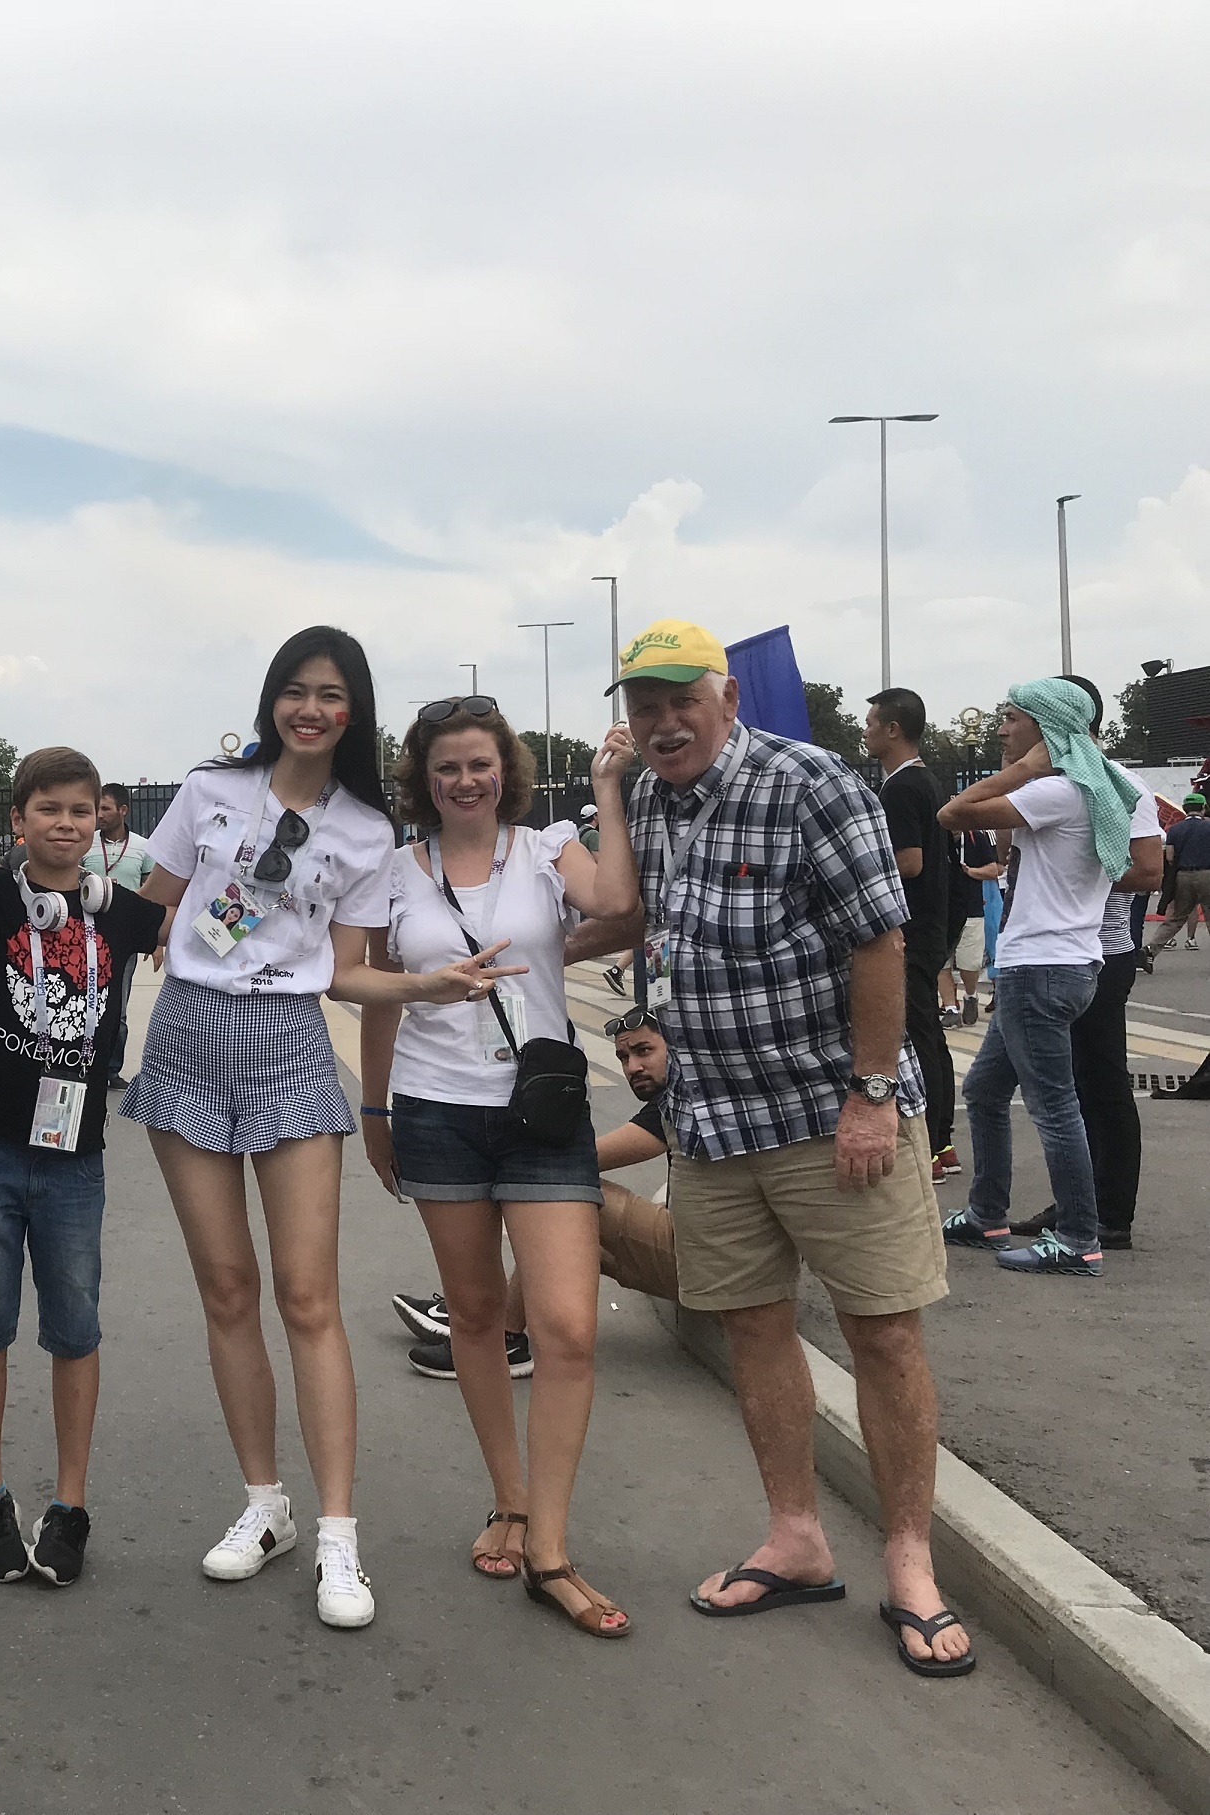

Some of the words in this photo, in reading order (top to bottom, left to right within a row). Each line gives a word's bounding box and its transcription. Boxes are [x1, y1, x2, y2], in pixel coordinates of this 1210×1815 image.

[257, 968, 294, 978] mplicity
[250, 977, 273, 985] 2018
[250, 985, 260, 993] in
